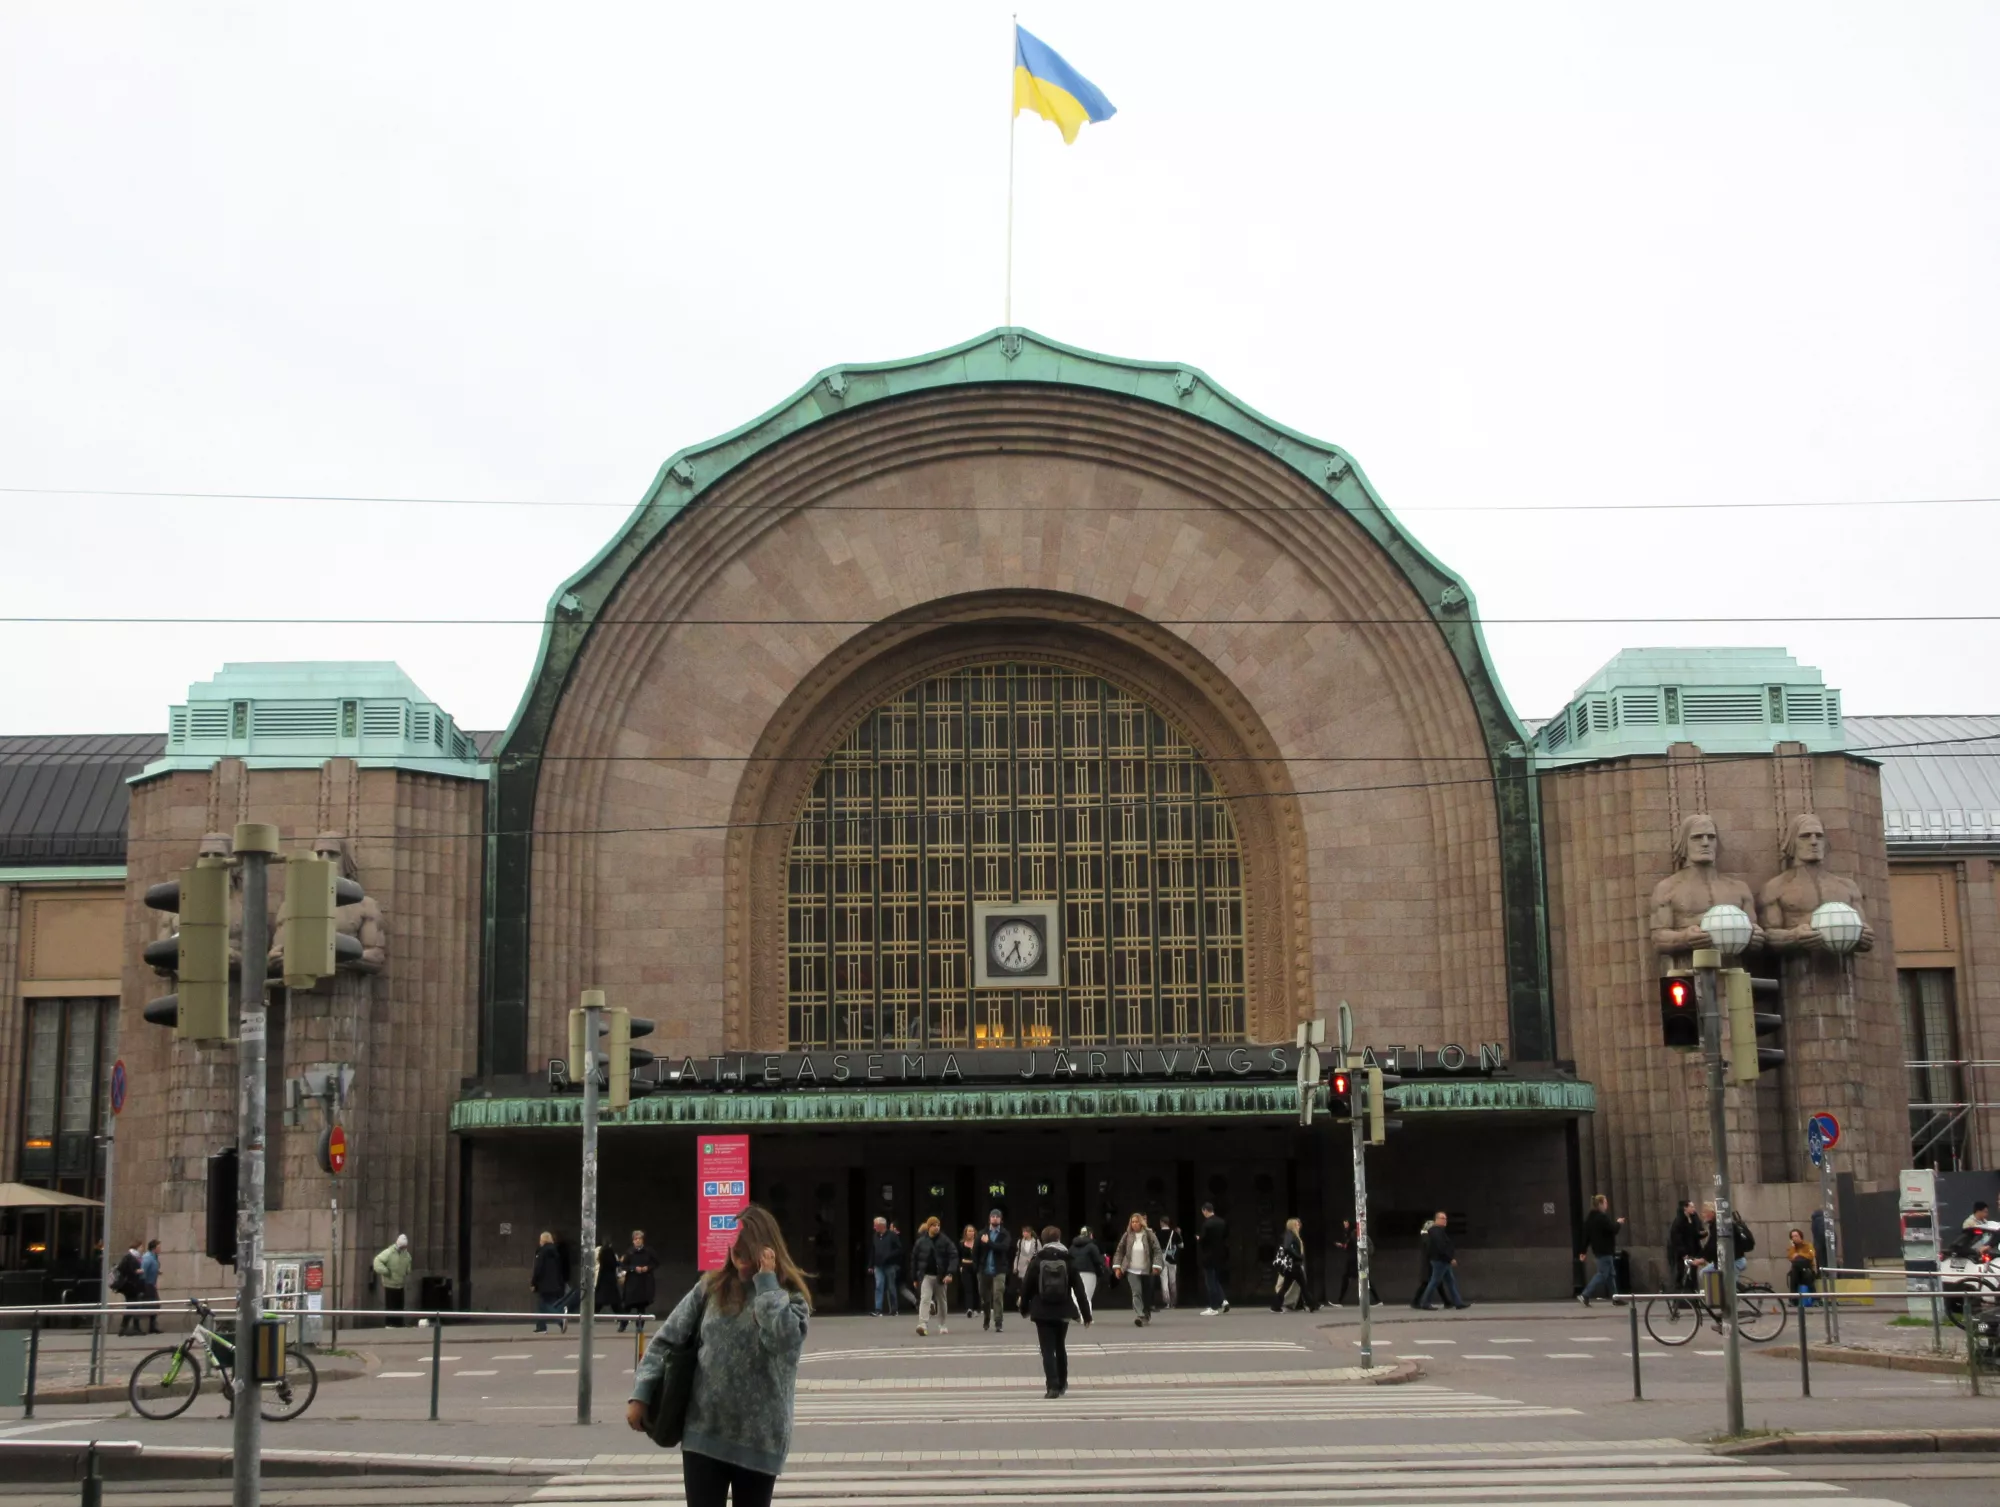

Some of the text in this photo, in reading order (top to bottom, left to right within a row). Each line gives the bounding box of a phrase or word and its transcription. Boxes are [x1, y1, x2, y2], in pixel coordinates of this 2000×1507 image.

[548, 1044, 1501, 1085] RTATIEASEMA JÄRNVÄGSTATION
[720, 1183, 730, 1194] M
